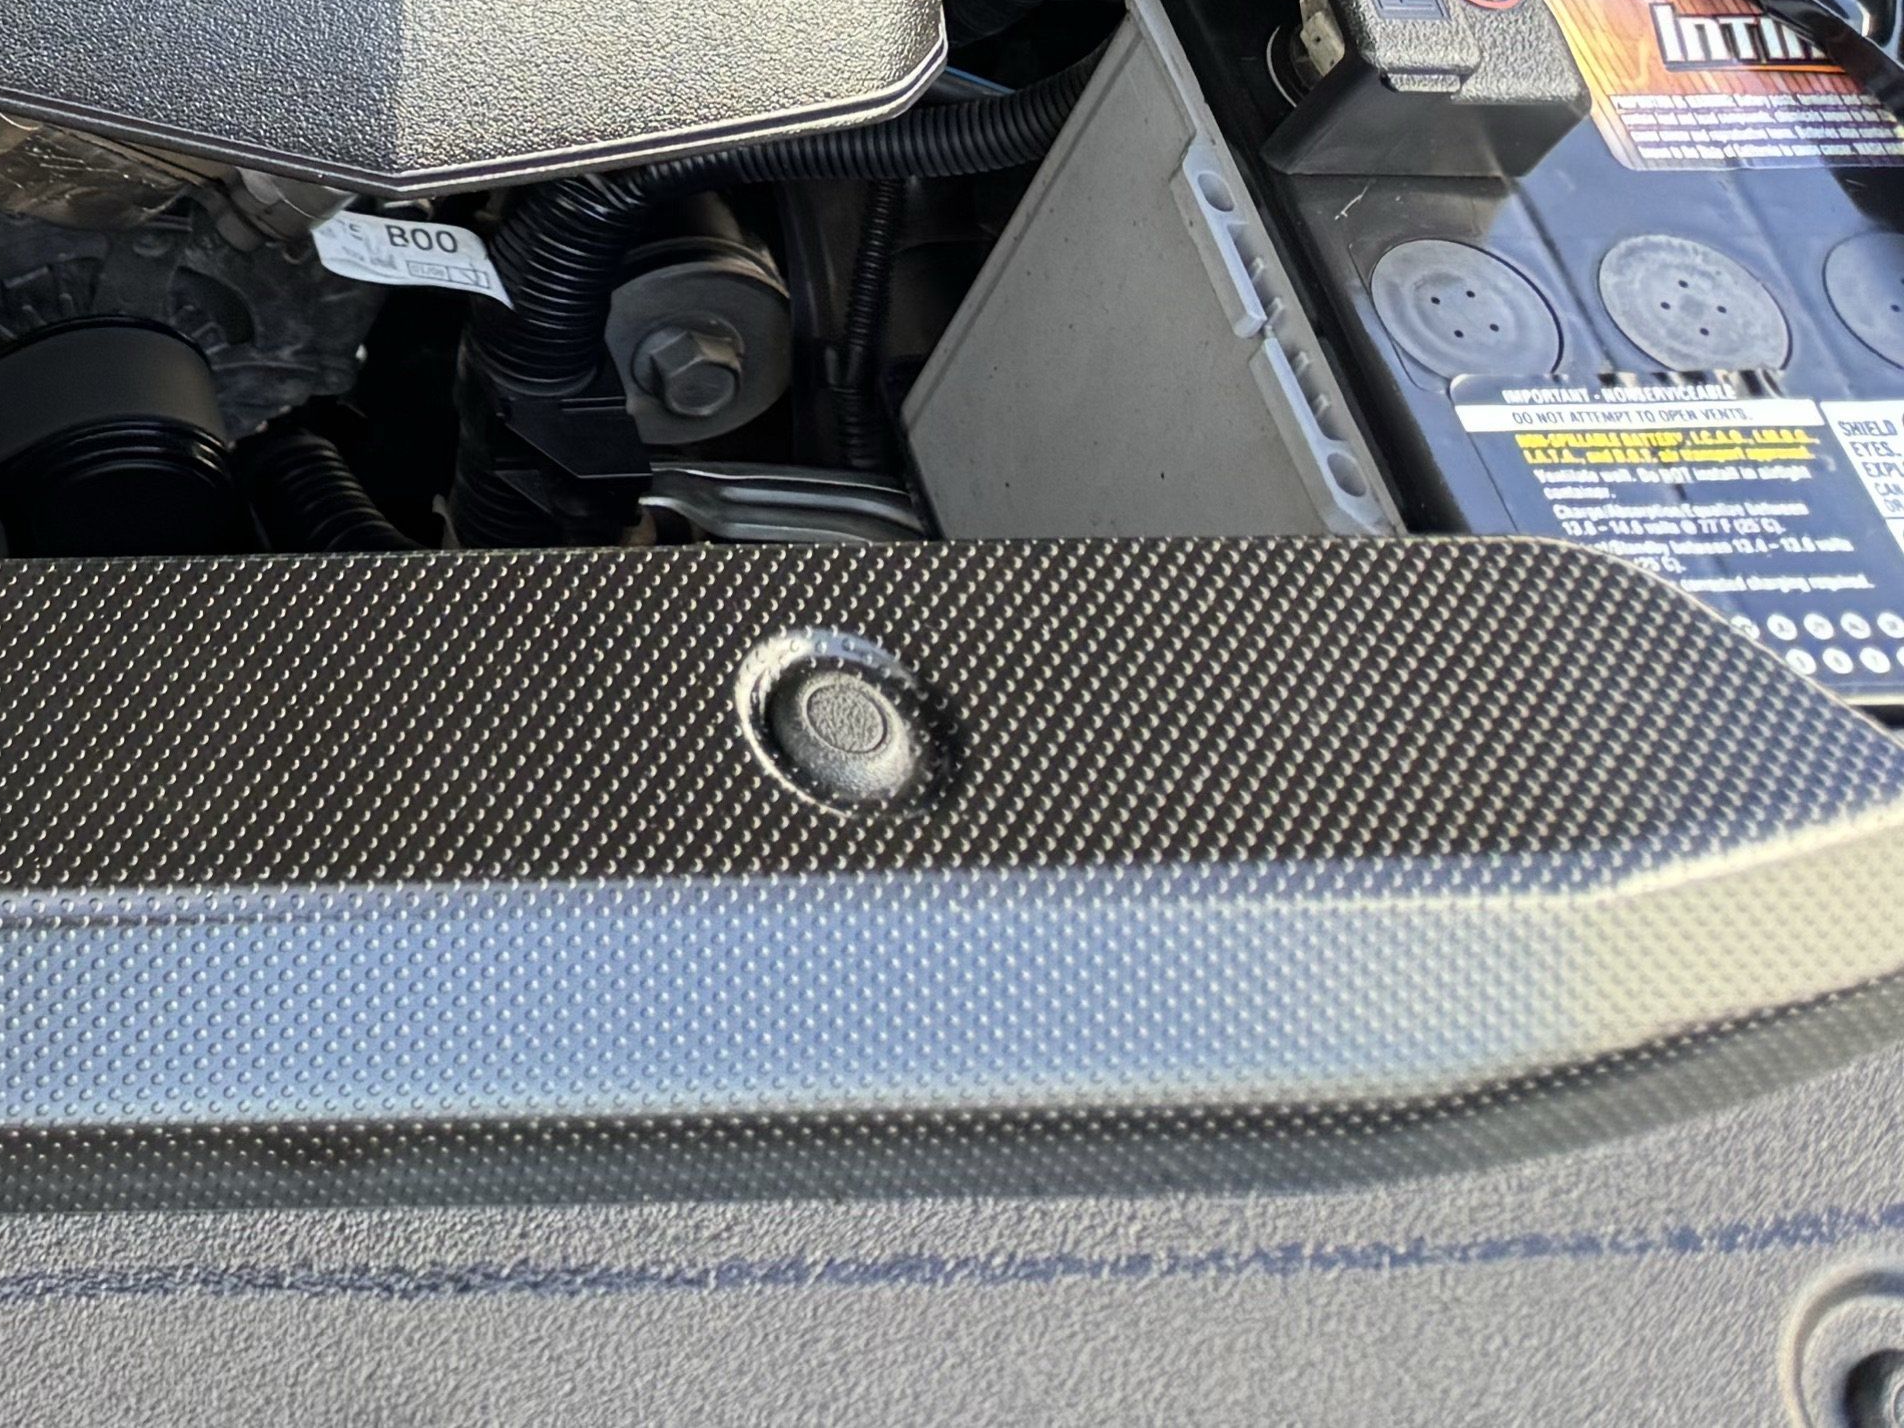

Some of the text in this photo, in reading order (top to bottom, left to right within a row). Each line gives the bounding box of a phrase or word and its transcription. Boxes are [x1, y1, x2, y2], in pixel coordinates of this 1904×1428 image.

[1501, 387, 1590, 404] IMPORTANT
[1601, 384, 1737, 403] NONSERVICEABLE
[1512, 407, 1754, 425] DO NOT ATTEMPT TO OPEN VENTS.
[1837, 419, 1899, 437] SHIELD
[1848, 440, 1903, 458] EYES.
